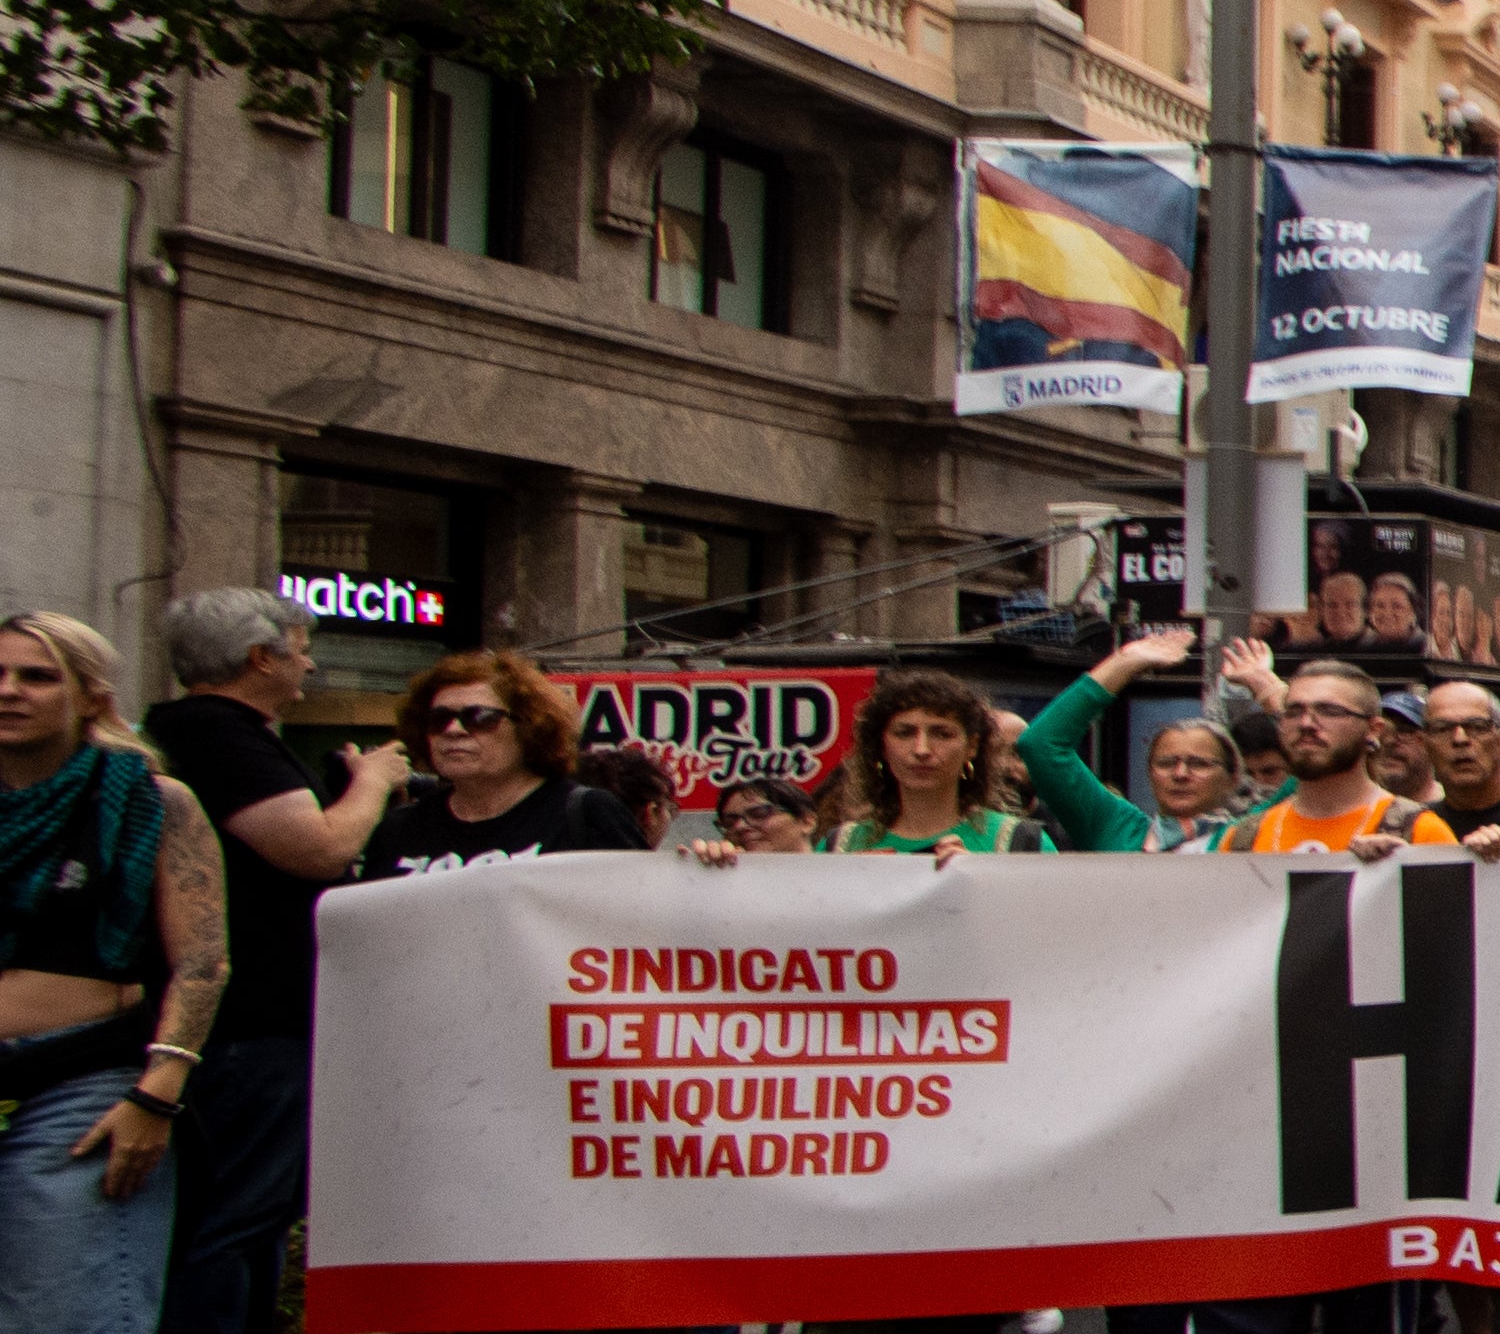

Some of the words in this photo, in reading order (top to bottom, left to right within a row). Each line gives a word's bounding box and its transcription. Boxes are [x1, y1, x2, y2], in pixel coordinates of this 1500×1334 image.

[1275, 217, 1371, 246] FIESTA
[1275, 245, 1431, 278] NACIONAL
[1272, 313, 1299, 341] 12
[1301, 305, 1451, 344] OCTUBRE
[1027, 374, 1123, 401] MADRID
[1122, 553, 1149, 583] EL
[553, 681, 838, 751] ADRID
[702, 735, 820, 788] Tour
[567, 947, 899, 994] SINDICATO
[565, 1013, 644, 1060] DE
[655, 1008, 999, 1063] INQUILINAS
[568, 1079, 599, 1123] E
[613, 1074, 953, 1127] INQUILINOS
[570, 1134, 642, 1179] DE
[652, 1132, 891, 1179] MADRID
